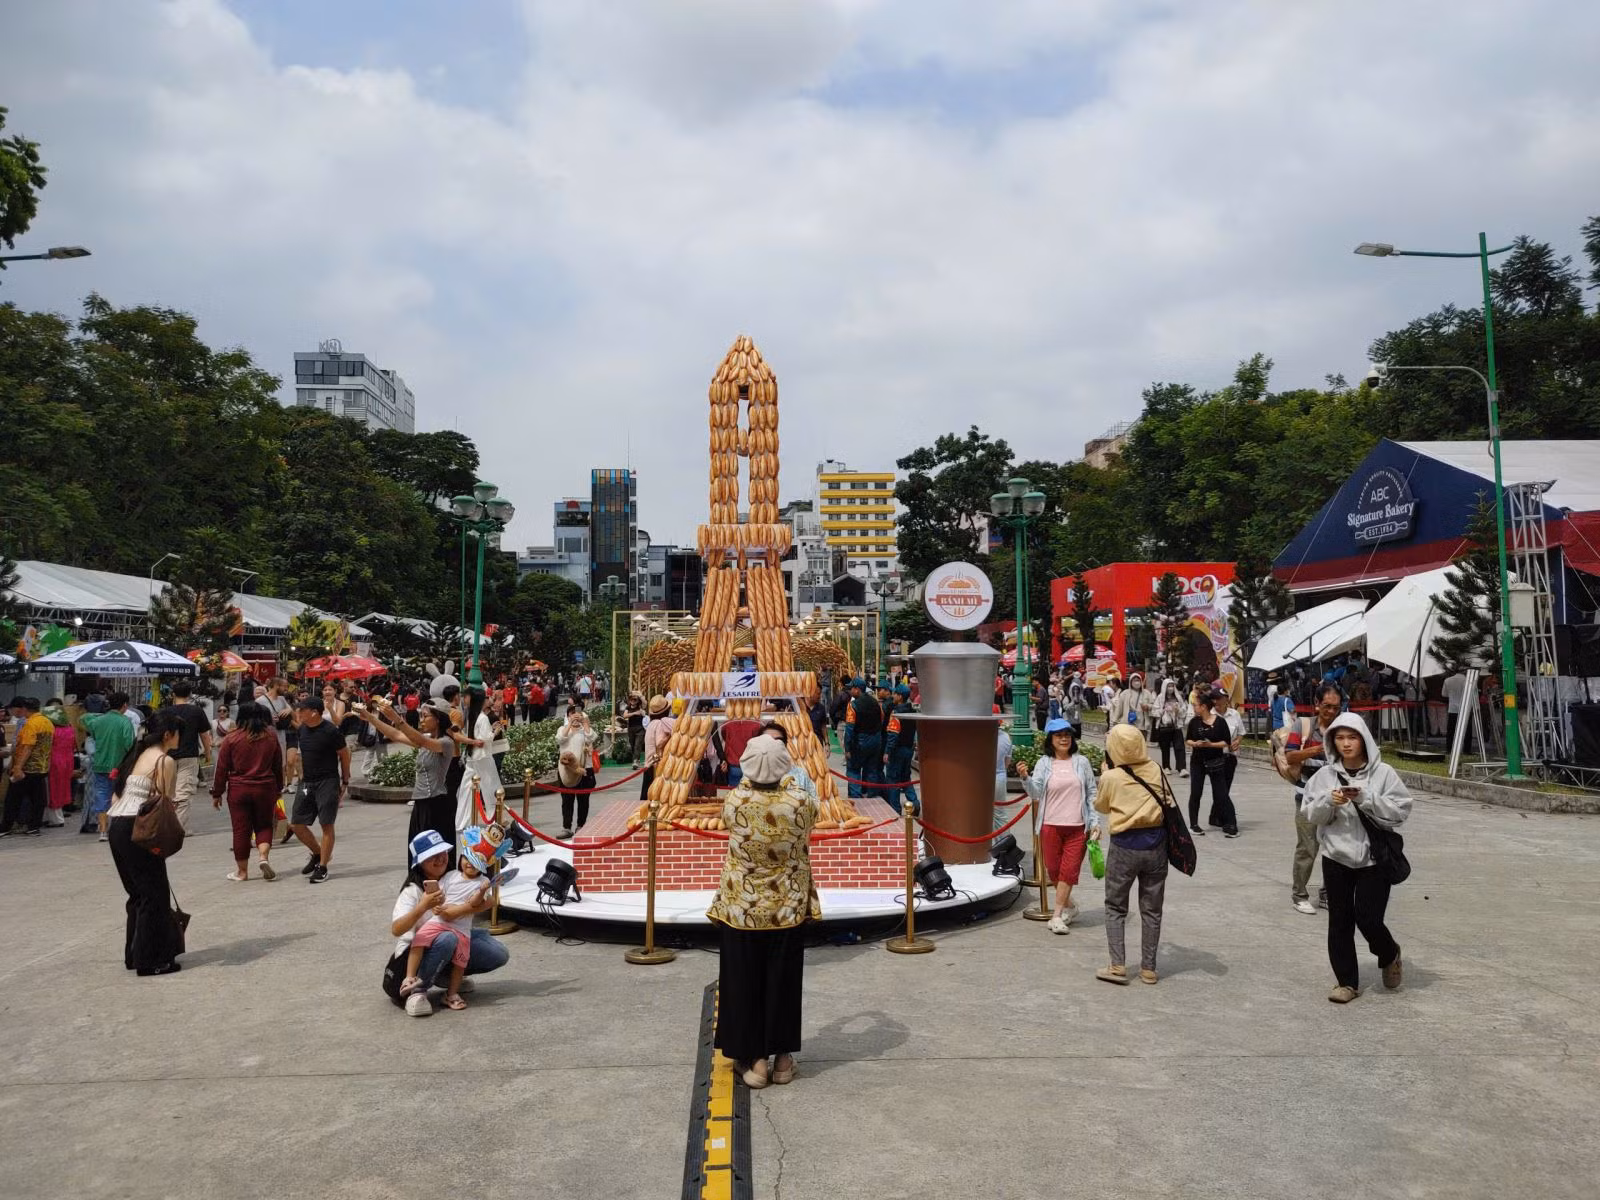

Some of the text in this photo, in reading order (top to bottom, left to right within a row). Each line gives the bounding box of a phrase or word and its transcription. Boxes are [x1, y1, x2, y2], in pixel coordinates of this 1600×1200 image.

[1370, 486, 1390, 503] ABC
[1347, 503, 1414, 528] Signature Bakery
